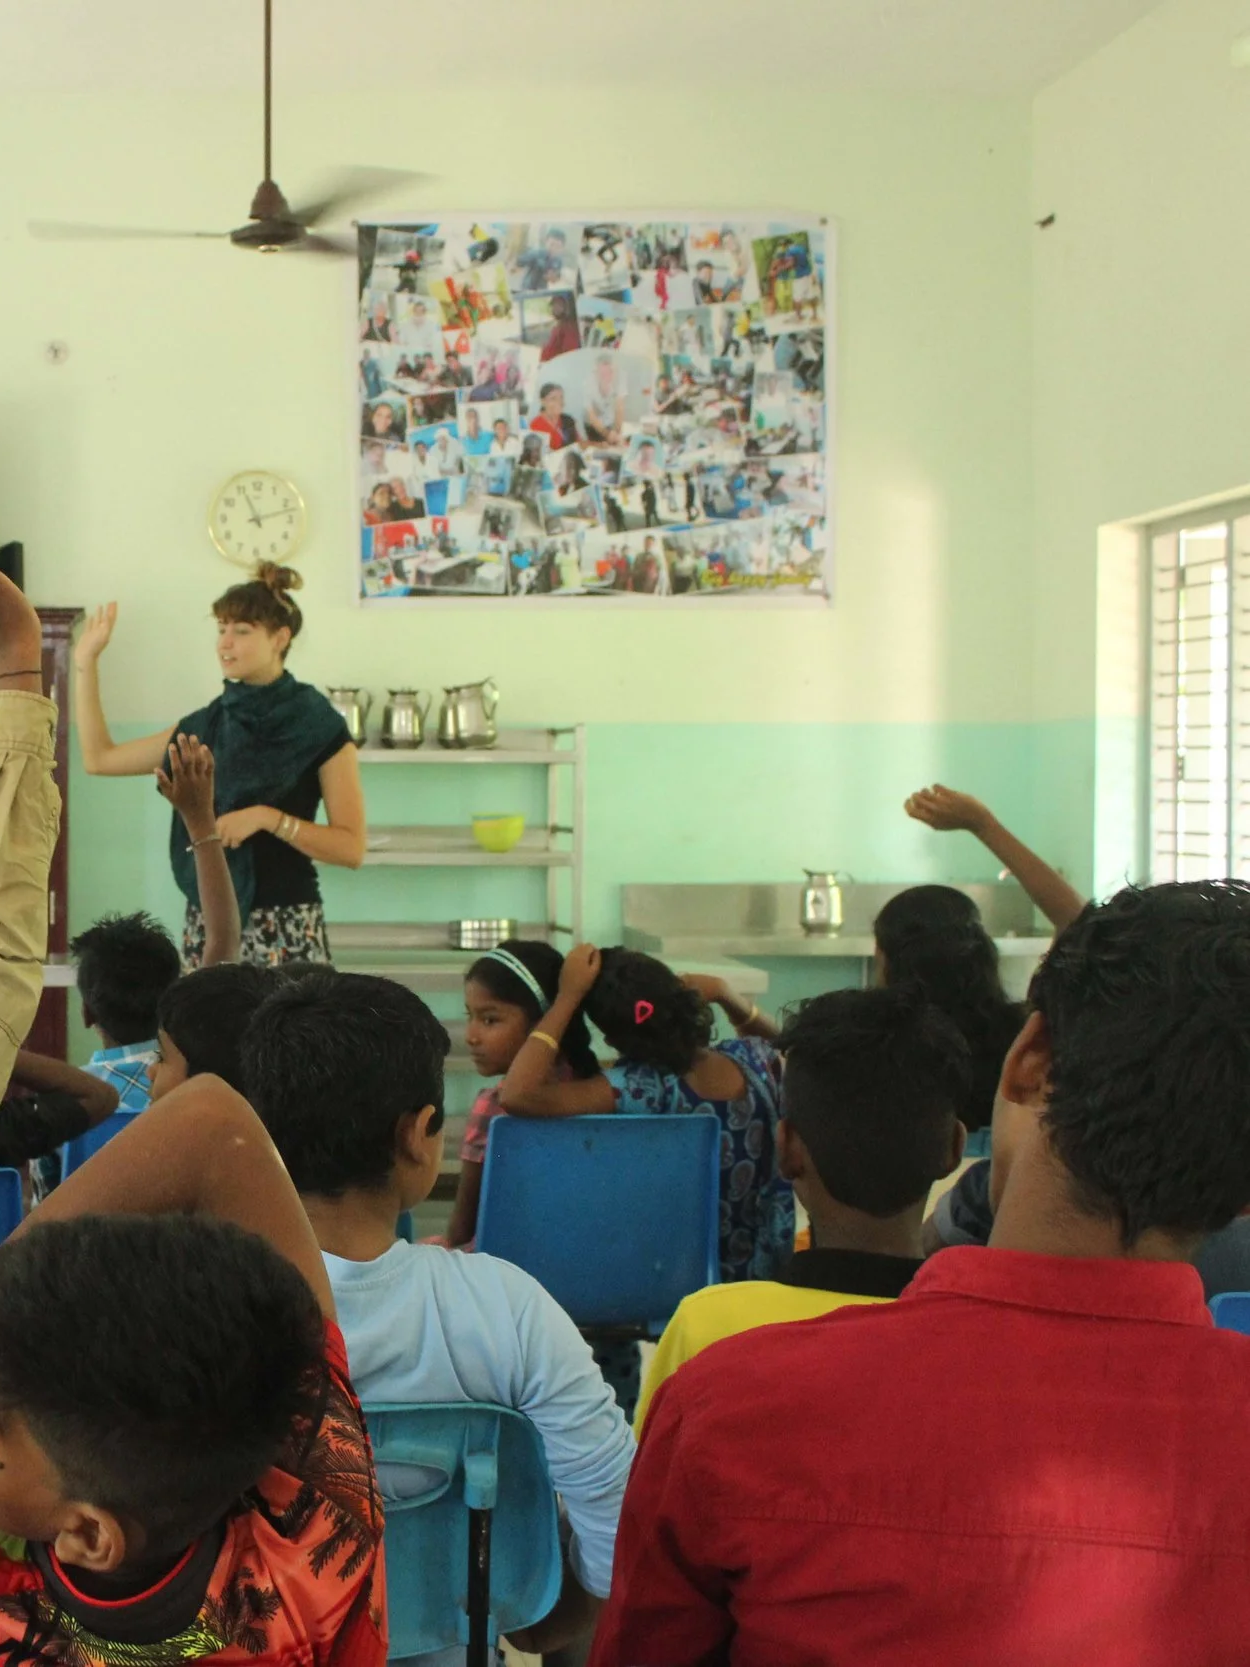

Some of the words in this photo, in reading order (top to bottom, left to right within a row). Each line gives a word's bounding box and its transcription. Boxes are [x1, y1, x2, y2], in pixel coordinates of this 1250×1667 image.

[236, 485, 246, 495] 11
[252, 481, 263, 491] 12
[271, 486, 277, 495] 1
[224, 498, 235, 507] 10
[282, 498, 289, 507] 2
[220, 514, 228, 523] 9
[286, 515, 293, 524] 3
[224, 530, 232, 540] 8
[282, 531, 289, 540] 4
[236, 542, 244, 552] 7
[252, 547, 260, 556] 6
[270, 543, 277, 553] 5
